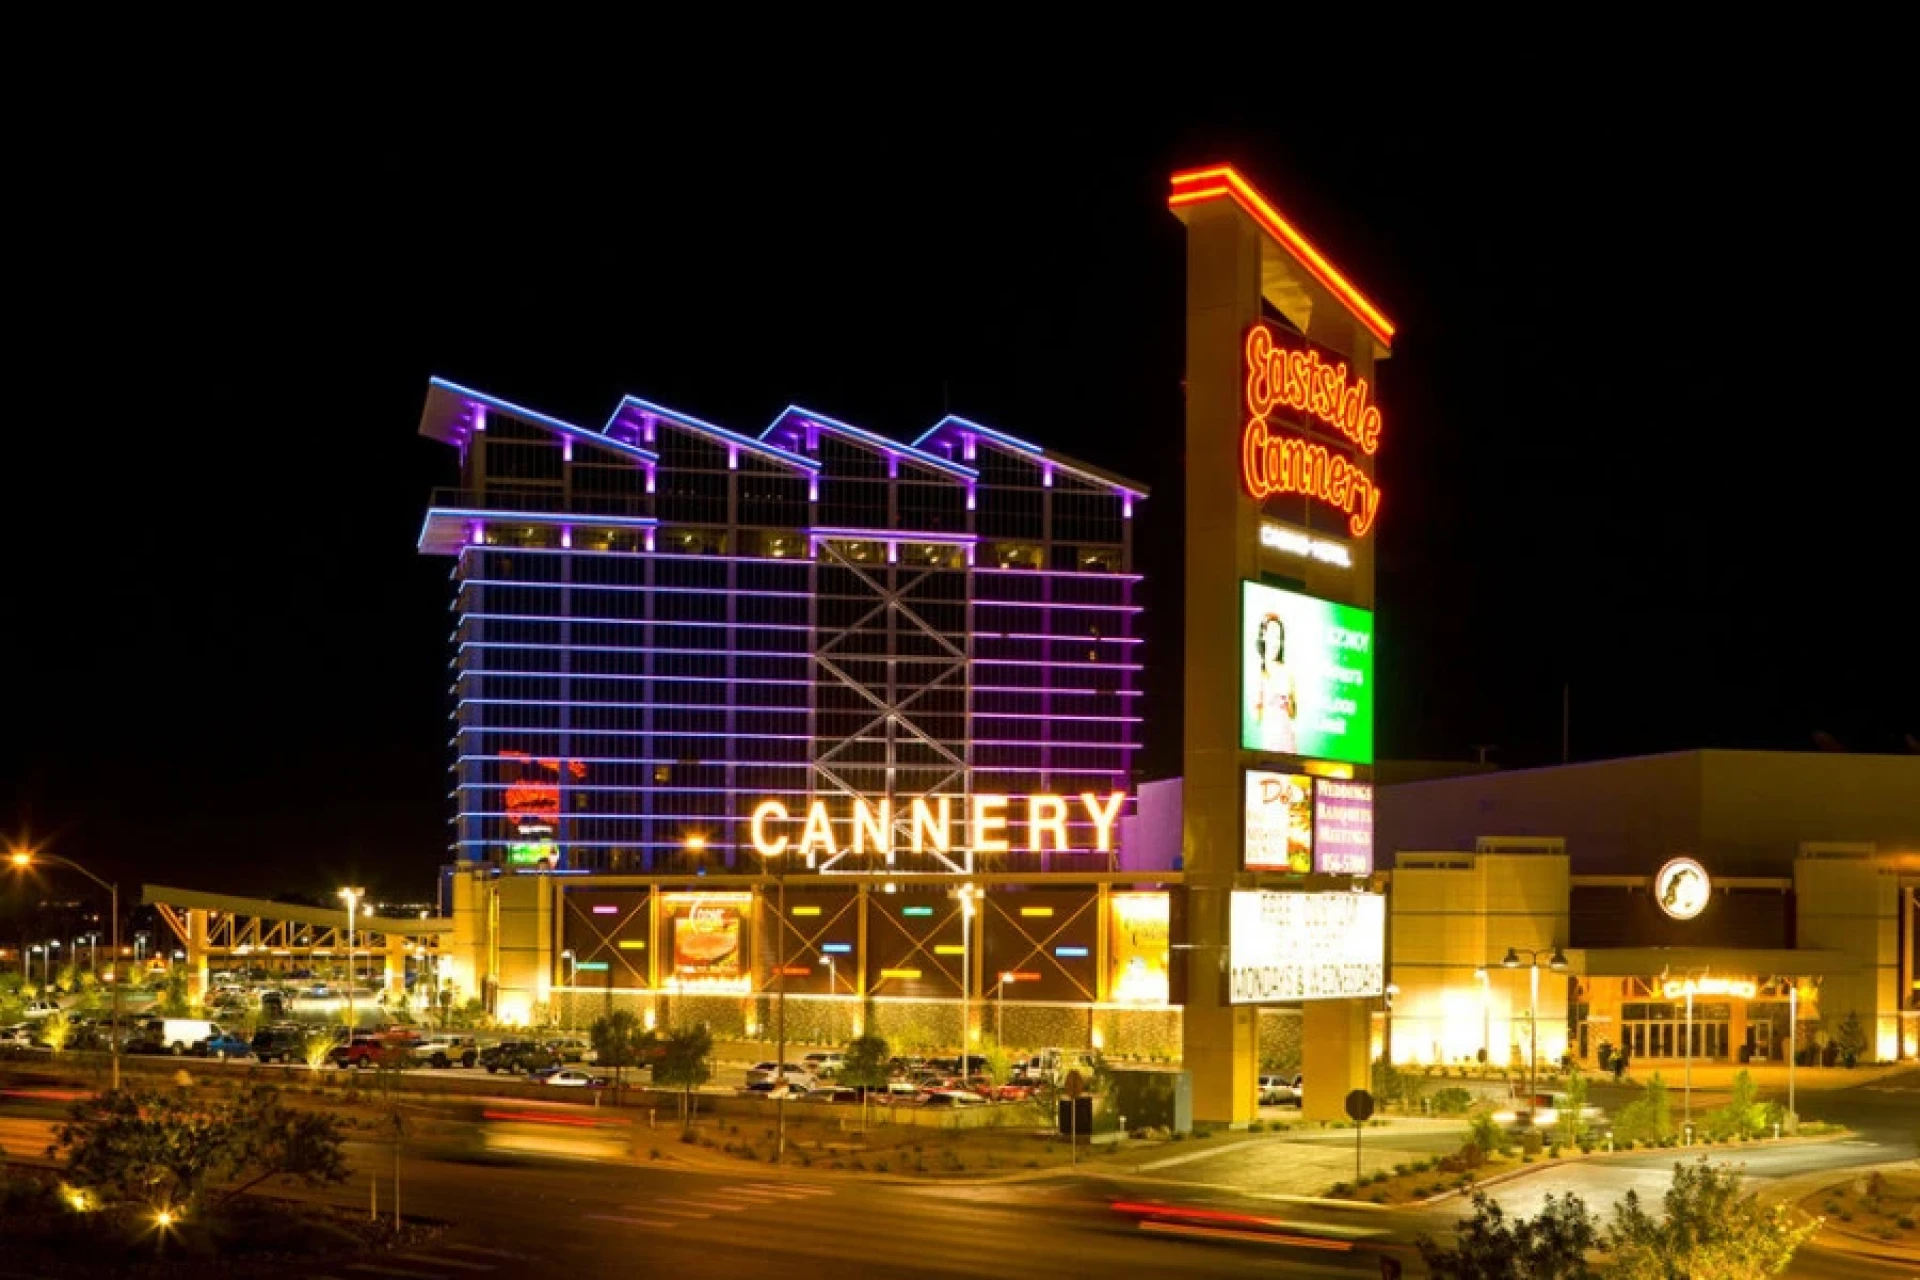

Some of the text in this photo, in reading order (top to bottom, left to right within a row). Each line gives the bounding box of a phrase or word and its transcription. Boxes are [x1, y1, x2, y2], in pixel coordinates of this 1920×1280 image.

[1247, 326, 1382, 454] Eastside
[1244, 417, 1381, 536] Cannery
[750, 791, 1126, 857] CANNERY
